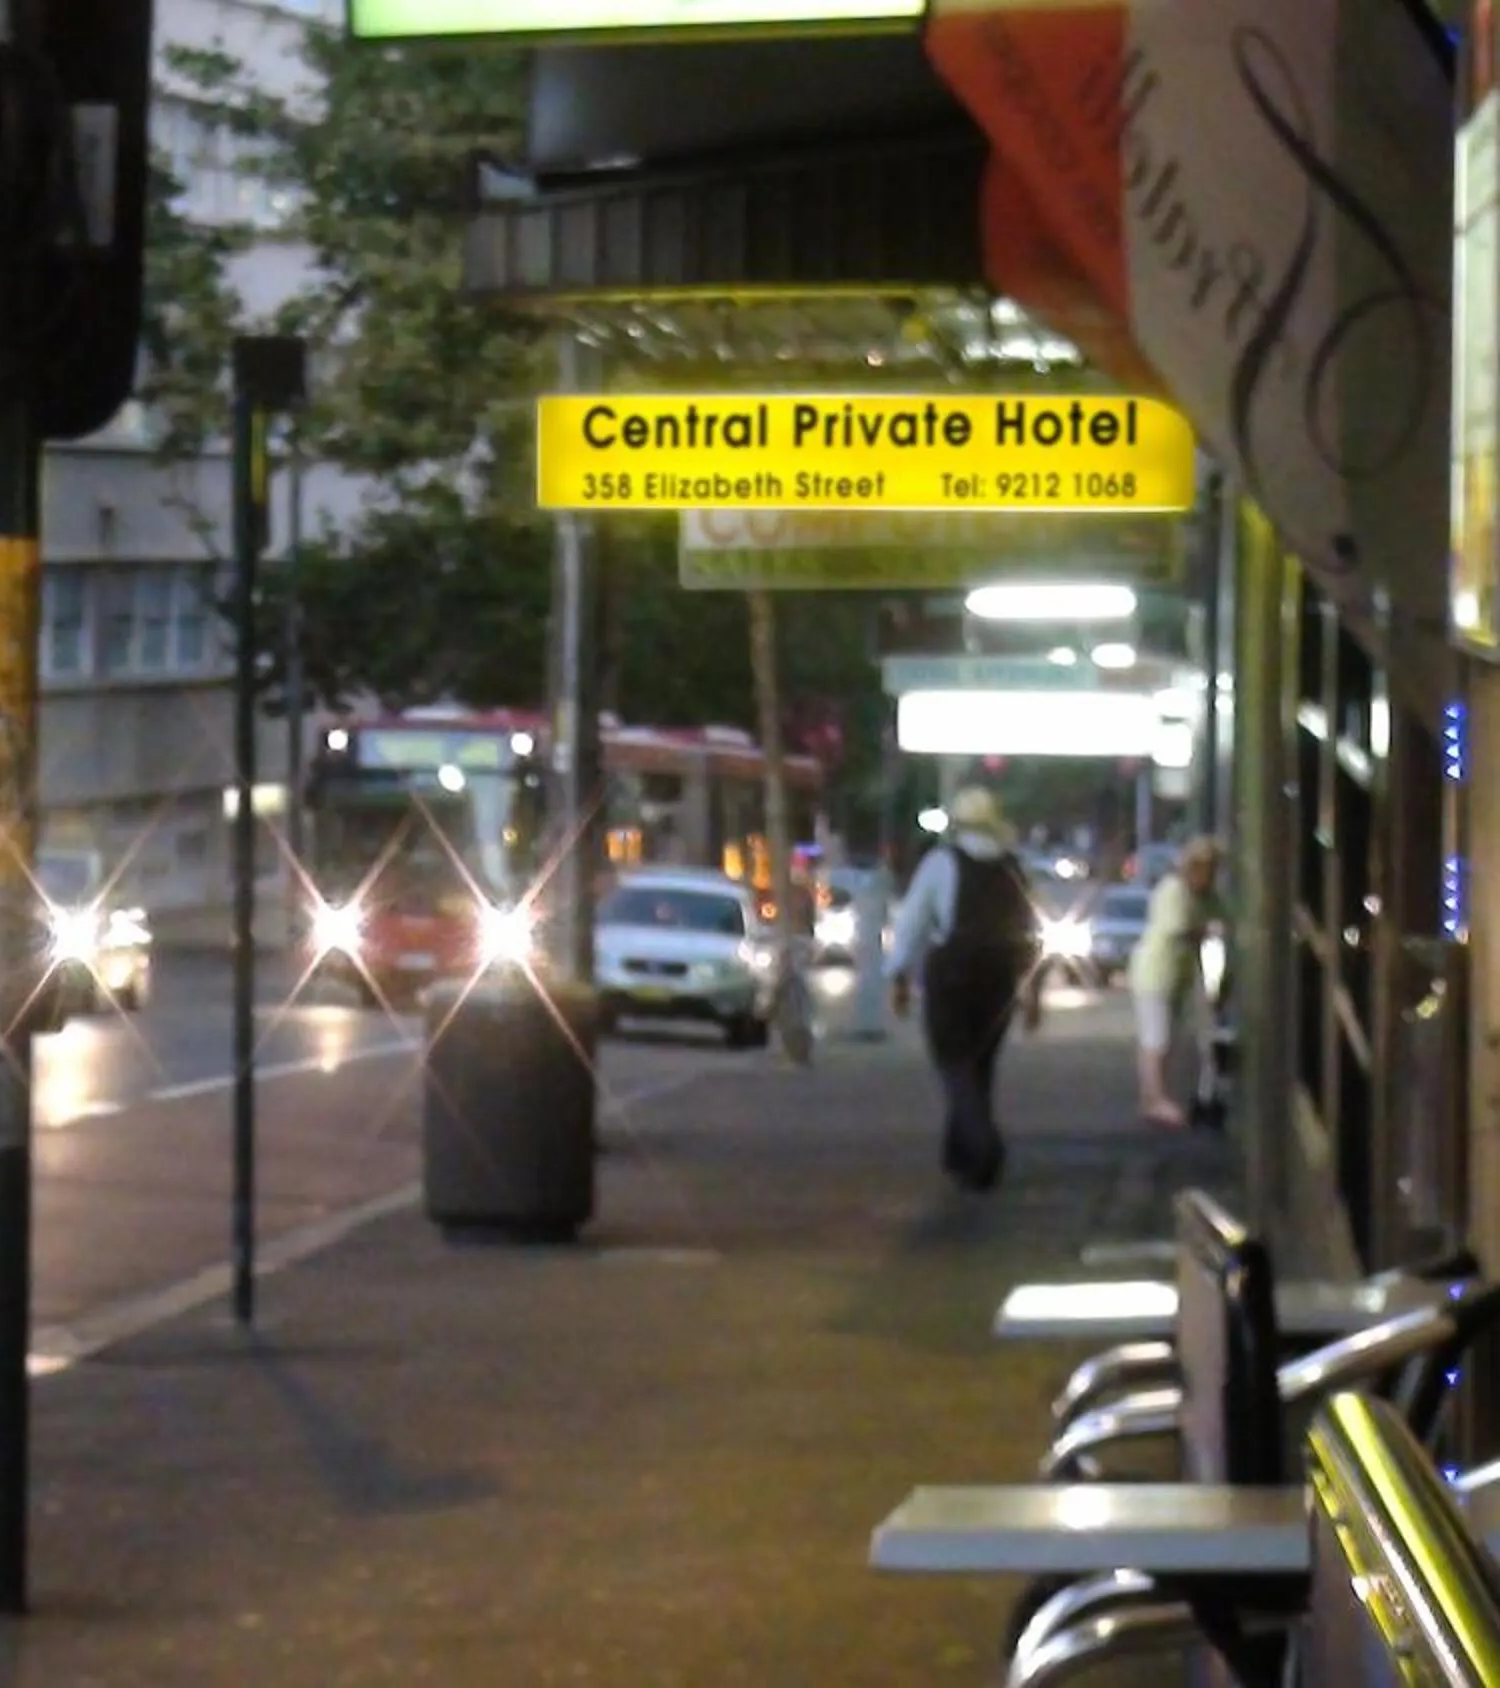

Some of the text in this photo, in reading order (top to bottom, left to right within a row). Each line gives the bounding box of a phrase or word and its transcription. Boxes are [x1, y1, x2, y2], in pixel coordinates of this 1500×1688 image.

[582, 400, 1137, 449] Central Private Hotel
[582, 471, 1137, 500] 358 Elizabeth Street Tel: 9212 1068
